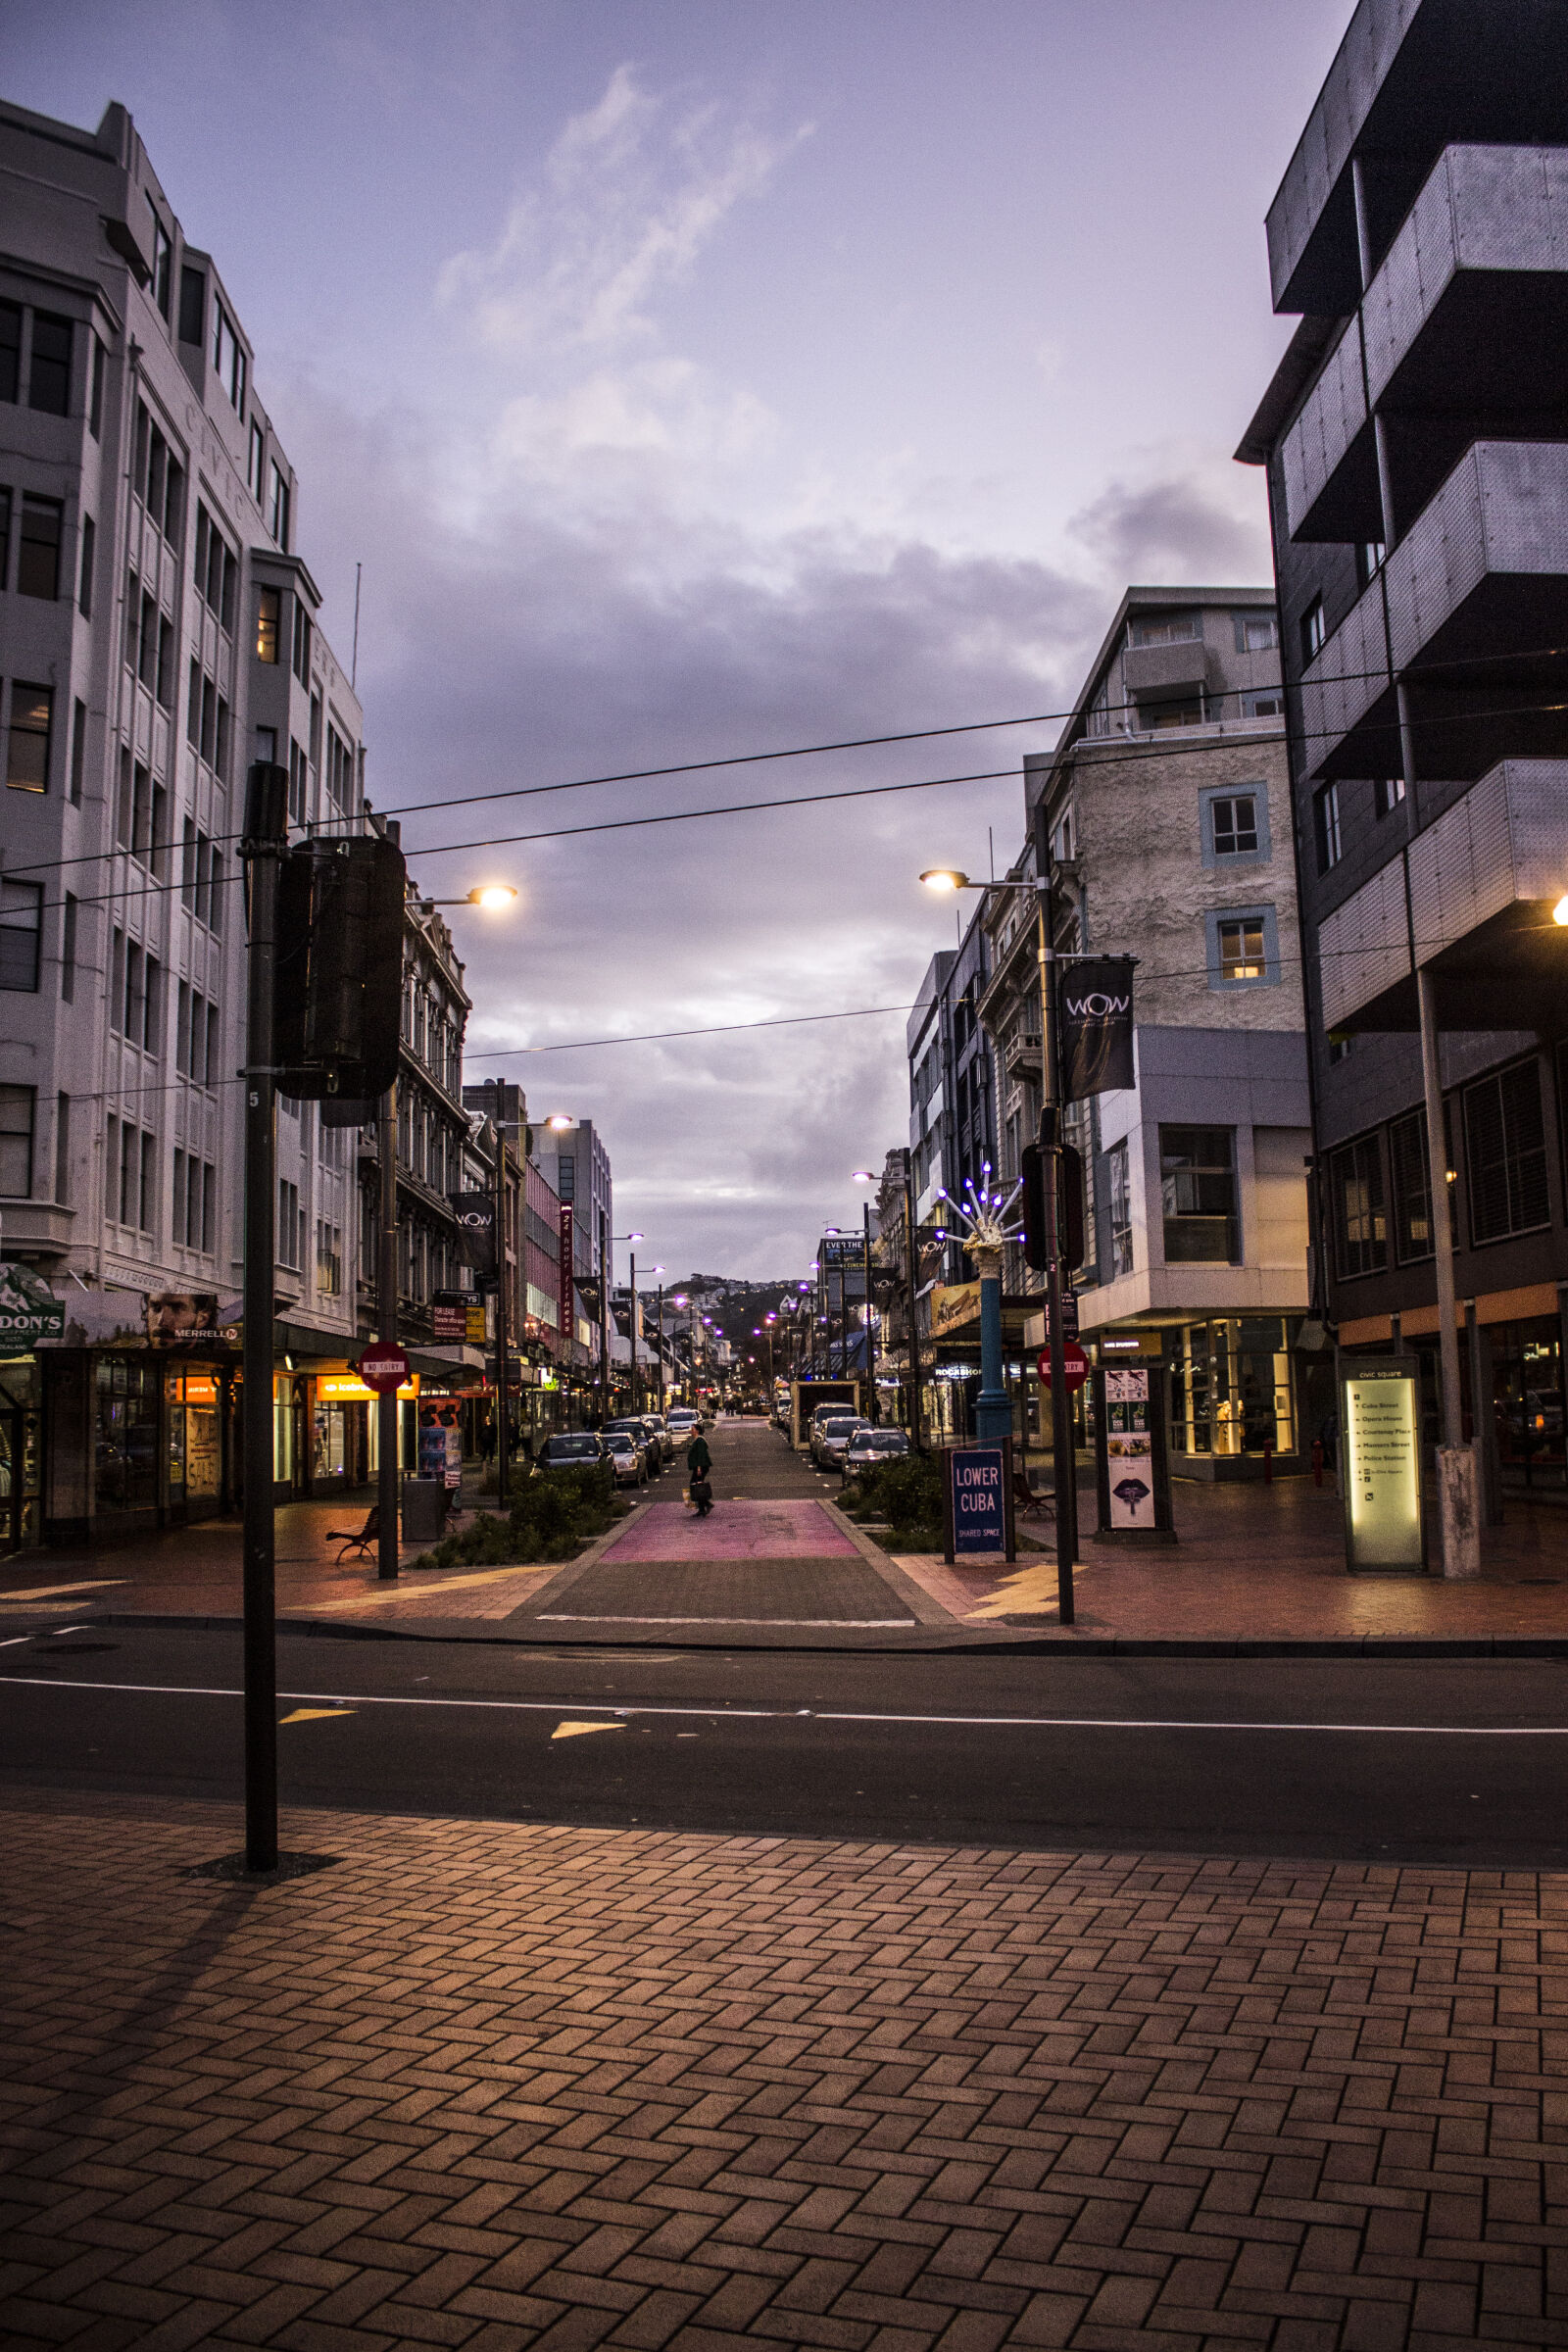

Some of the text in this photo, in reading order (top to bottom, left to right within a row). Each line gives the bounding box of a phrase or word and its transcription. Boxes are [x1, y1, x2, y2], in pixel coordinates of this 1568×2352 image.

[1066, 993, 1129, 1016] WOW
[249, 1091, 259, 1107] 5
[455, 1212, 492, 1226] WOW
[917, 1241, 946, 1252] WOW
[1050, 1263, 1056, 1272] 2
[873, 1279, 896, 1289] WOW
[174, 1328, 226, 1338] MERRELL
[956, 1466, 999, 1487] LOWER
[960, 1492, 996, 1512] CUBA
[958, 1528, 1001, 1538] SHARED SPACE
